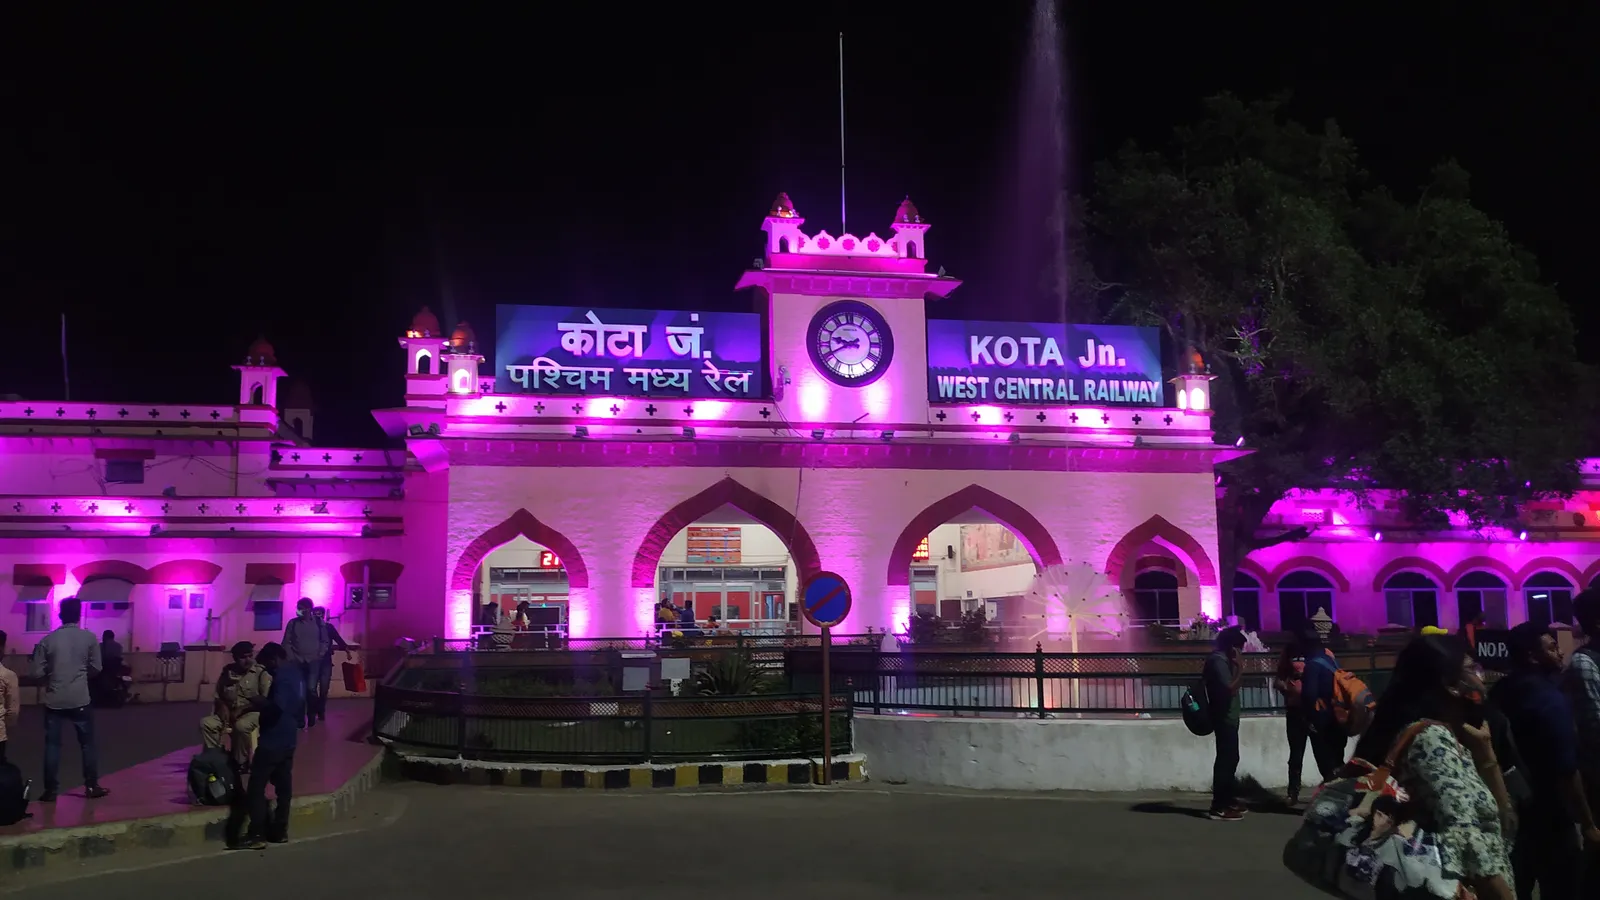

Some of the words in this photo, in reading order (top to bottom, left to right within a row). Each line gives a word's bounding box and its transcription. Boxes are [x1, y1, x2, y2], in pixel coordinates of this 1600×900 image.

[558, 310, 647, 357] कोटा
[666, 313, 711, 359] जं.
[970, 335, 1064, 367] KOTA
[1078, 338, 1126, 368] Jn.
[506, 356, 614, 391] पश्चिम
[623, 367, 692, 392] मध्य
[701, 360, 753, 393] रेल
[937, 375, 990, 399] WEST
[994, 376, 1080, 401] CENTRAL
[1084, 380, 1160, 403] RAILWAY
[1478, 642, 1496, 657] NO
